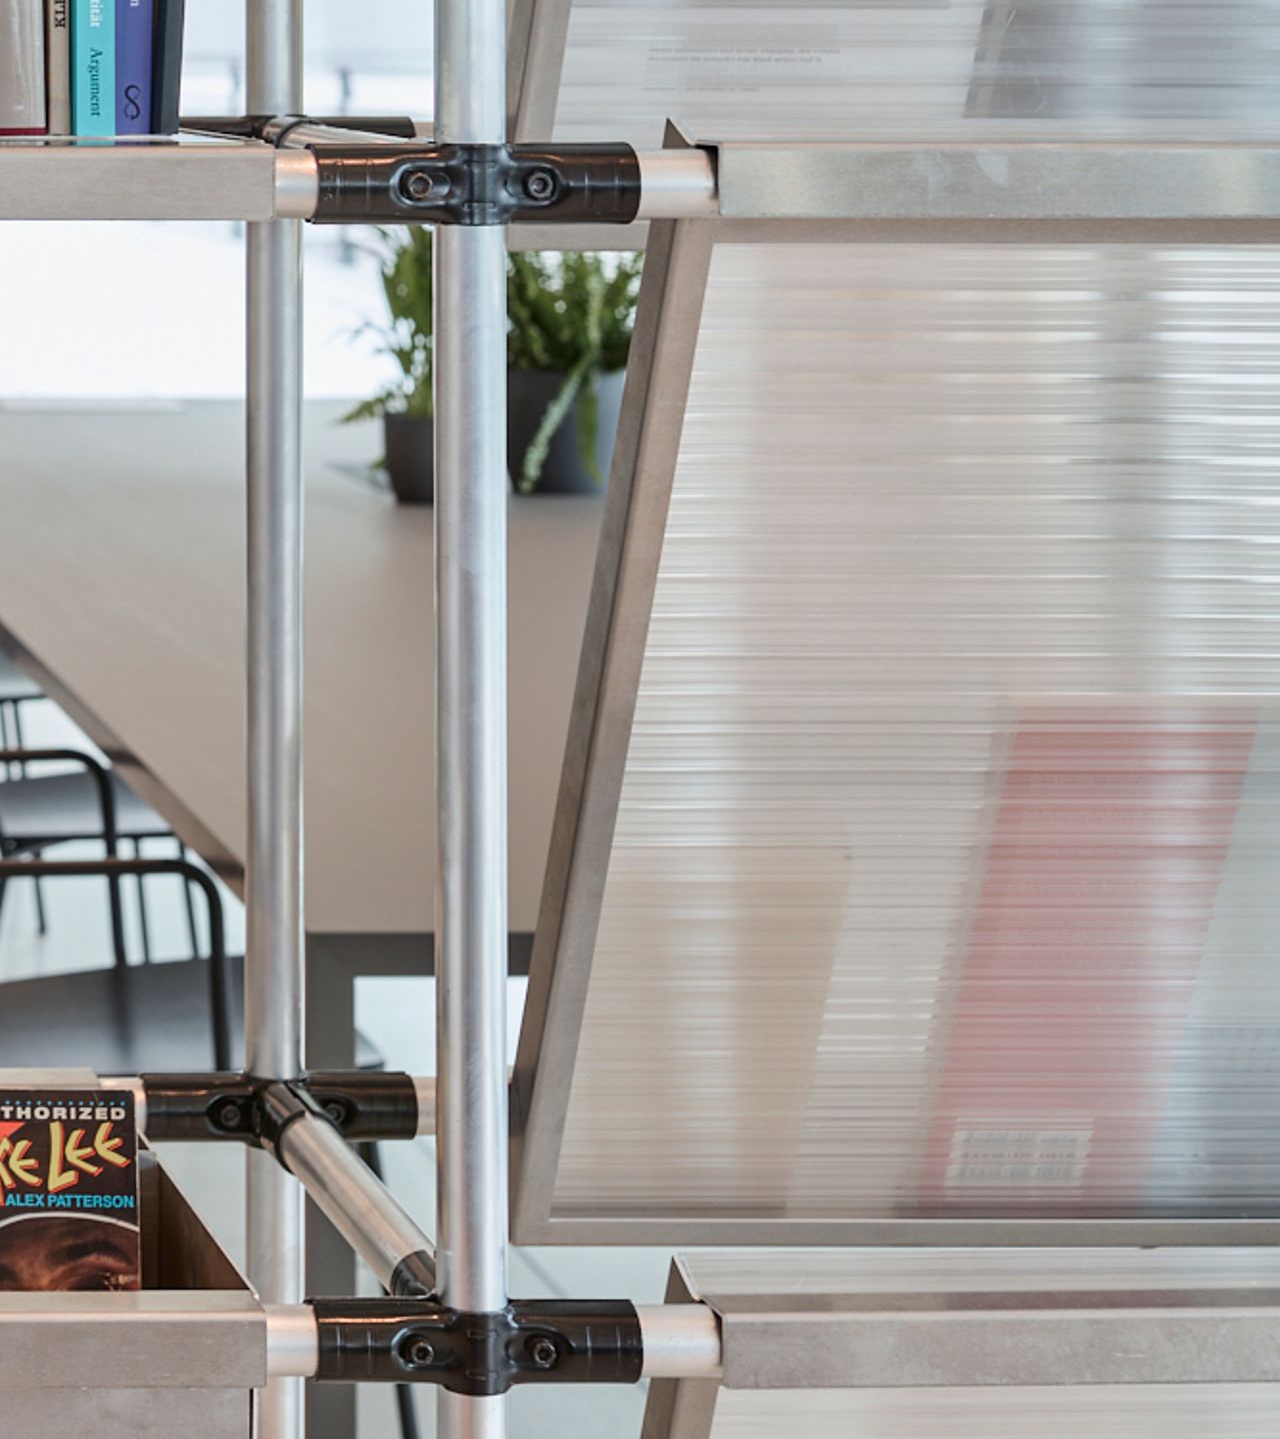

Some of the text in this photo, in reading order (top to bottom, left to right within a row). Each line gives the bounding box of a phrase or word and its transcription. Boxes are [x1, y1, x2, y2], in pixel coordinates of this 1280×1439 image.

[87, 47, 103, 117] Argument
[47, 1120, 131, 1194] LEE
[5, 1193, 135, 1209] ALEX PATTERSON
